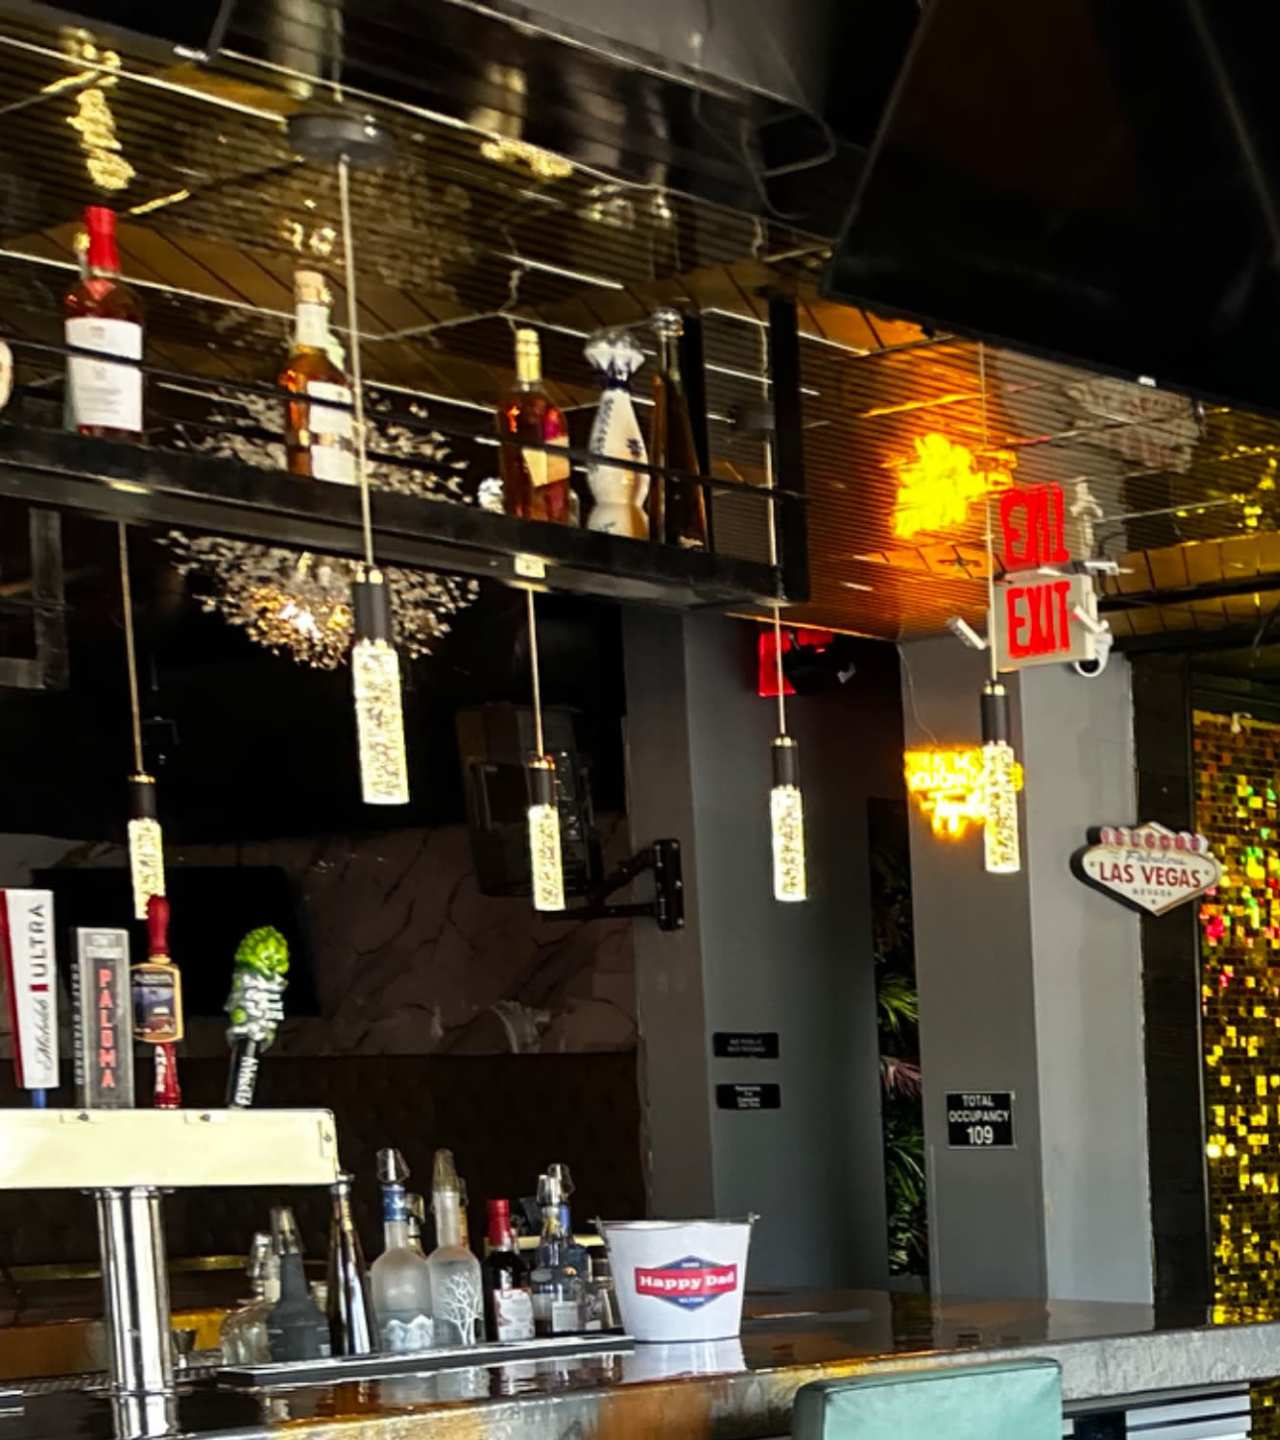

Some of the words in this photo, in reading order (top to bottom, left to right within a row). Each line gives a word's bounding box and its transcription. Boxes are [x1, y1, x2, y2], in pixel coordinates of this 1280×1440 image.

[1005, 580, 1071, 659] EXIT
[1099, 861, 1135, 883] LAS
[1141, 865, 1201, 889] VEGAS
[28, 903, 48, 979] ULTRA
[98, 968, 117, 1088] PALOMA
[962, 1094, 995, 1107] TOTAL
[948, 1110, 1009, 1122] OCCUPANCY
[966, 1125, 994, 1145] 109
[640, 1275, 702, 1291] Happy
[705, 1271, 735, 1287] Dad
